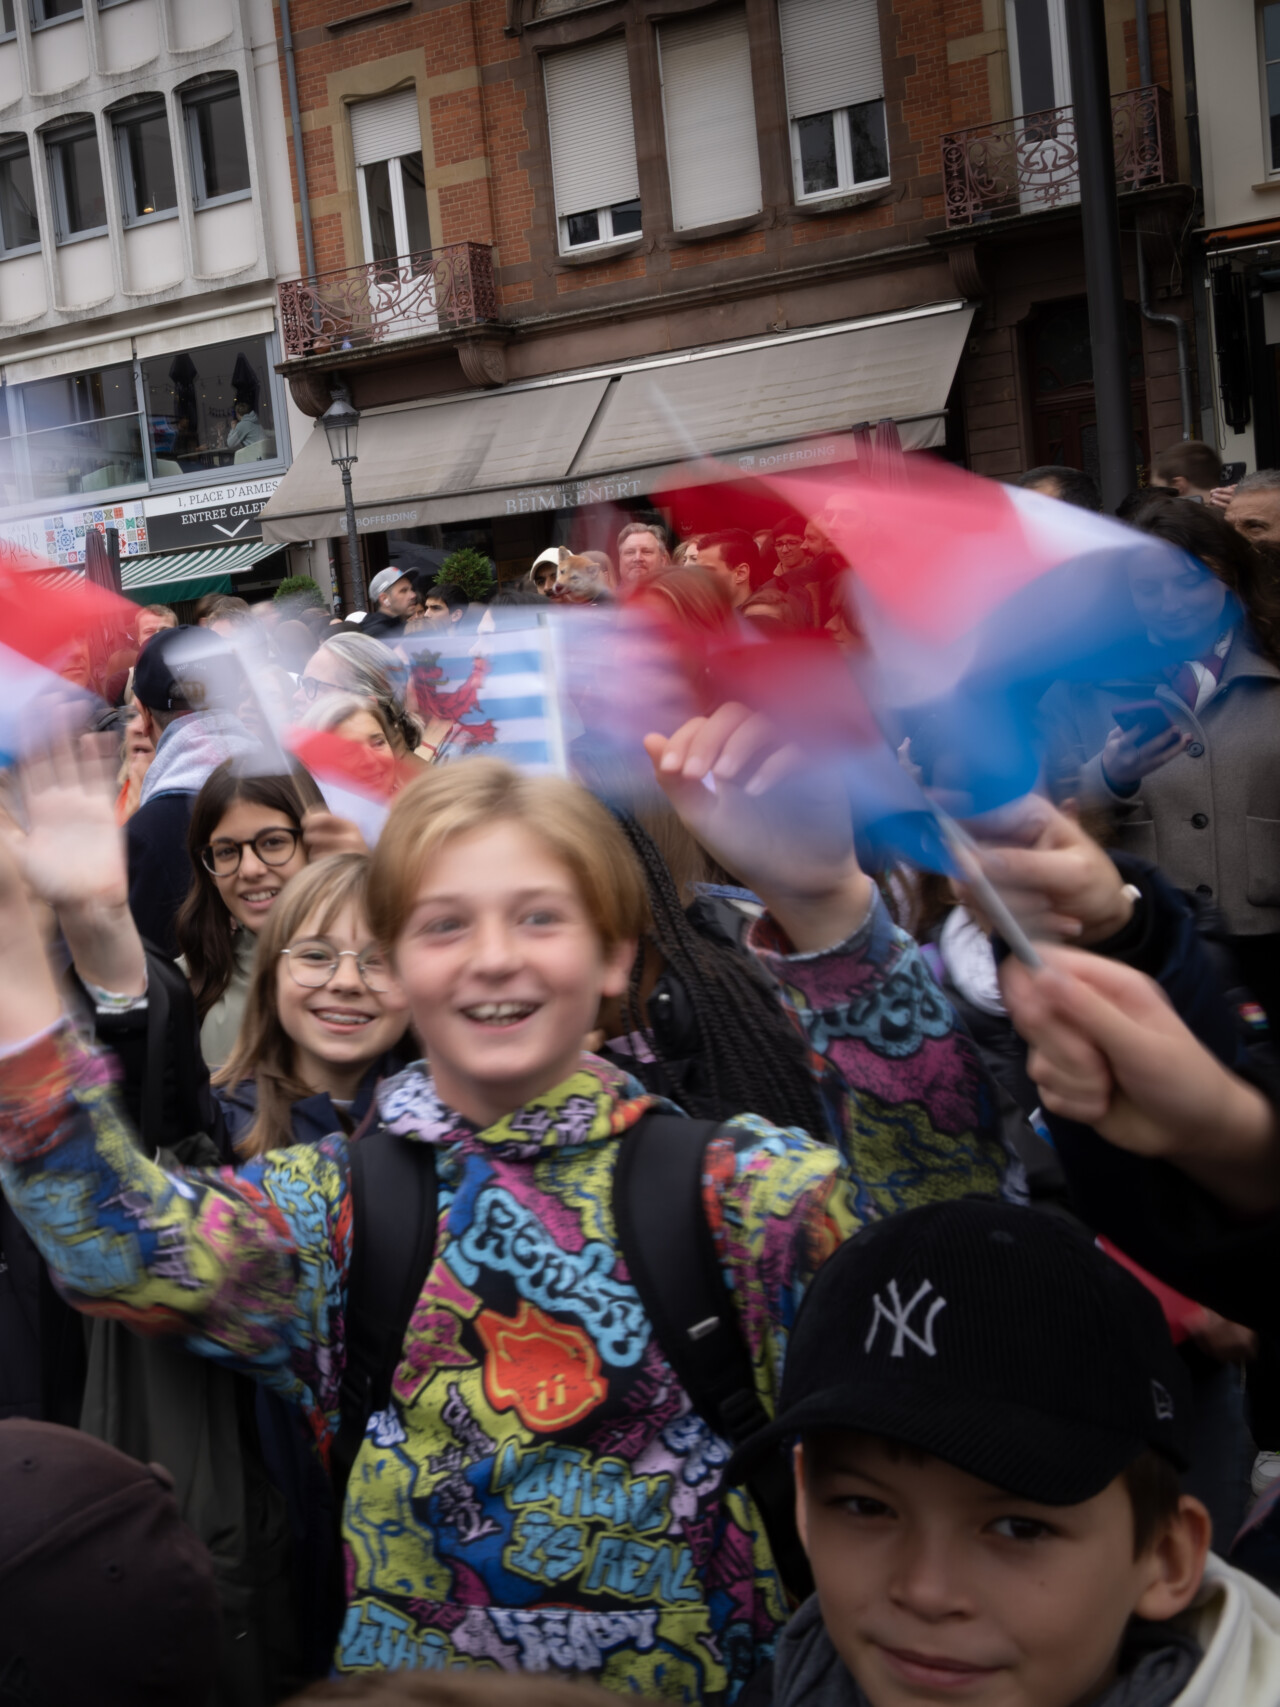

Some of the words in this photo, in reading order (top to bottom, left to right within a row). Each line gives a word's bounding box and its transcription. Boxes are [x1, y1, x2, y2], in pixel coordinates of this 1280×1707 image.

[759, 445, 836, 467] BOFFERDING
[189, 489, 224, 506] PLACE
[227, 480, 279, 499] D'ARMES
[505, 494, 556, 514] BEIM
[561, 479, 641, 508] RENERT
[555, 480, 590, 492] BISTRO
[180, 507, 228, 525] ENTREE
[356, 510, 418, 528] BOFFERDING
[864, 1278, 947, 1358] NY
[586, 1535, 702, 1603] REAL
